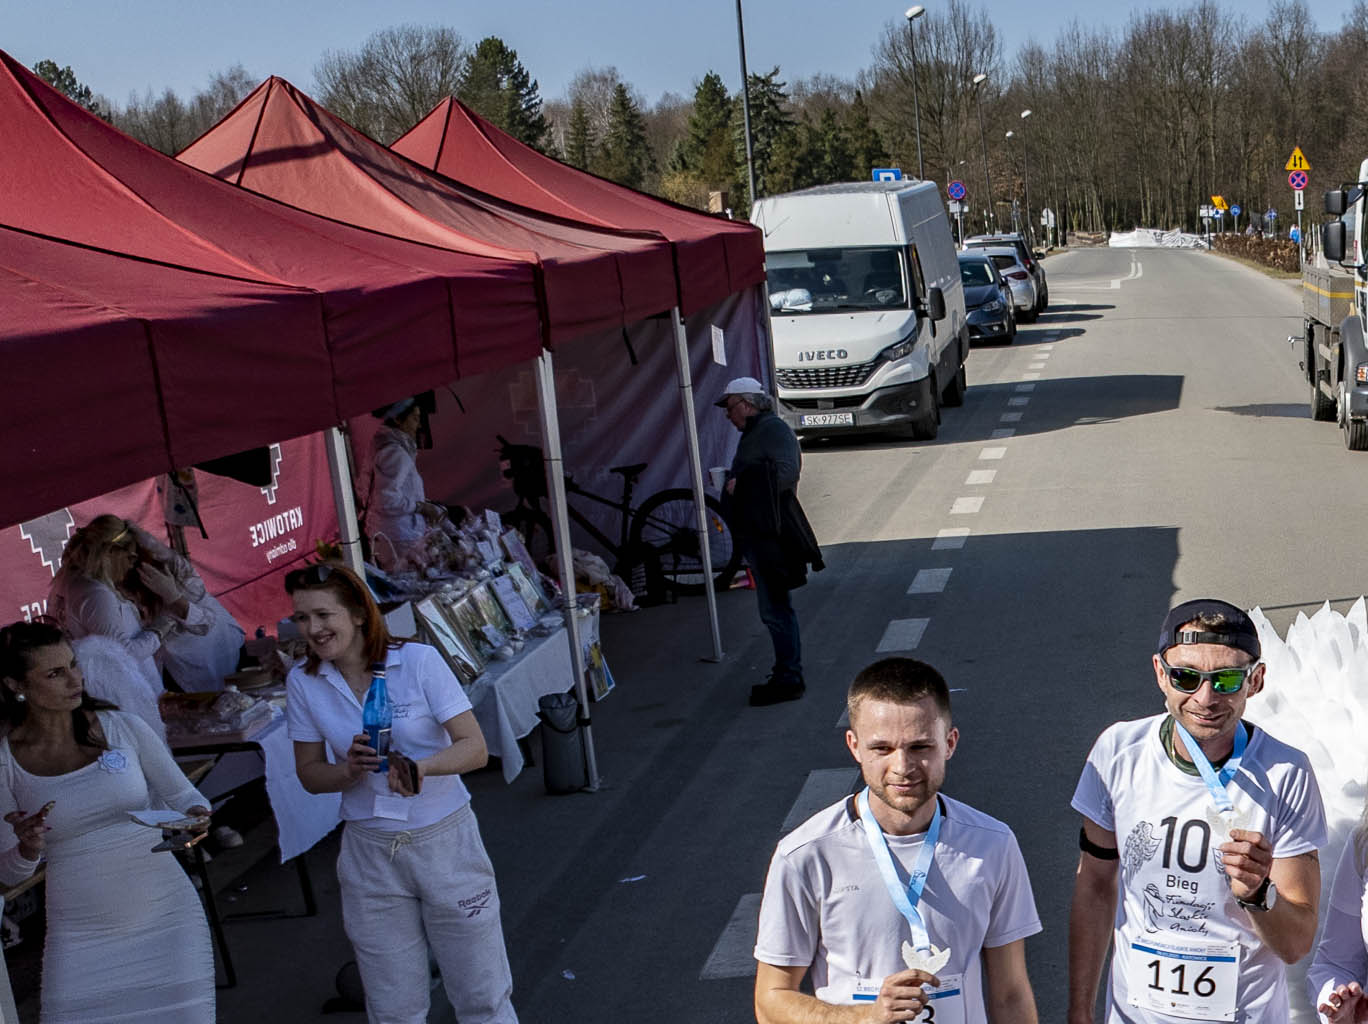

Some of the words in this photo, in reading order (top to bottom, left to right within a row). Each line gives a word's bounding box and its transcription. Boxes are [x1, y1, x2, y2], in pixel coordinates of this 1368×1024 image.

[797, 348, 849, 362] IVECO
[806, 416, 819, 425] SK
[1160, 816, 1211, 874] 10
[1166, 874, 1199, 894] Bieg
[457, 887, 492, 908] Reebok
[1147, 959, 1217, 998] 116
